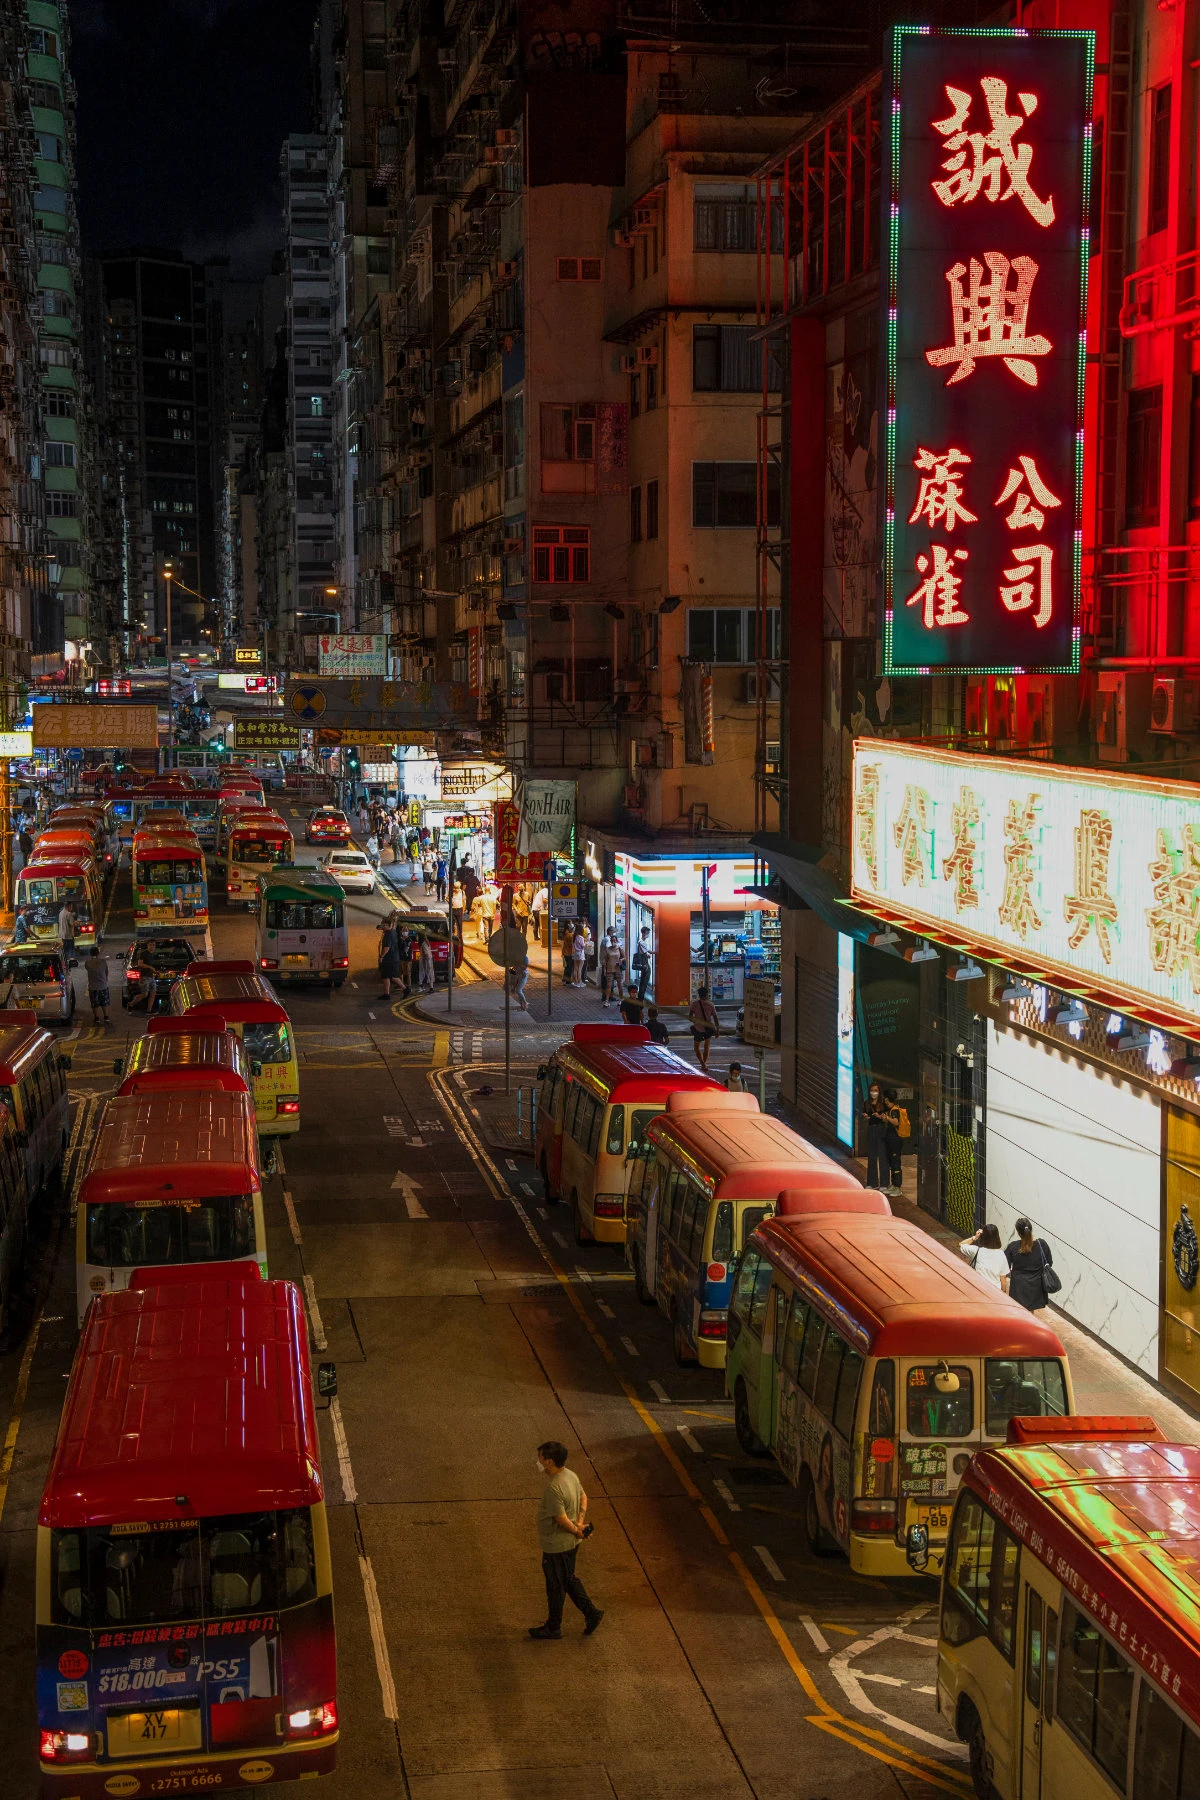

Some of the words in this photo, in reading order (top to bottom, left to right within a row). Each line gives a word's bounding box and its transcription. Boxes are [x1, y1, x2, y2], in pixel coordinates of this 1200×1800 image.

[995, 455, 1061, 628] 公司
[988, 1490, 1009, 1518] PUBLIC
[1010, 1511, 1029, 1538] LIGHT
[1030, 1530, 1045, 1553] BUS
[1056, 1558, 1080, 1589] SEATS
[196, 1658, 241, 1682] PS5
[144, 1712, 164, 1726] XV
[141, 1724, 167, 1739] 417
[158, 1778, 187, 1790] 2751
[191, 1774, 223, 1786] 6666
